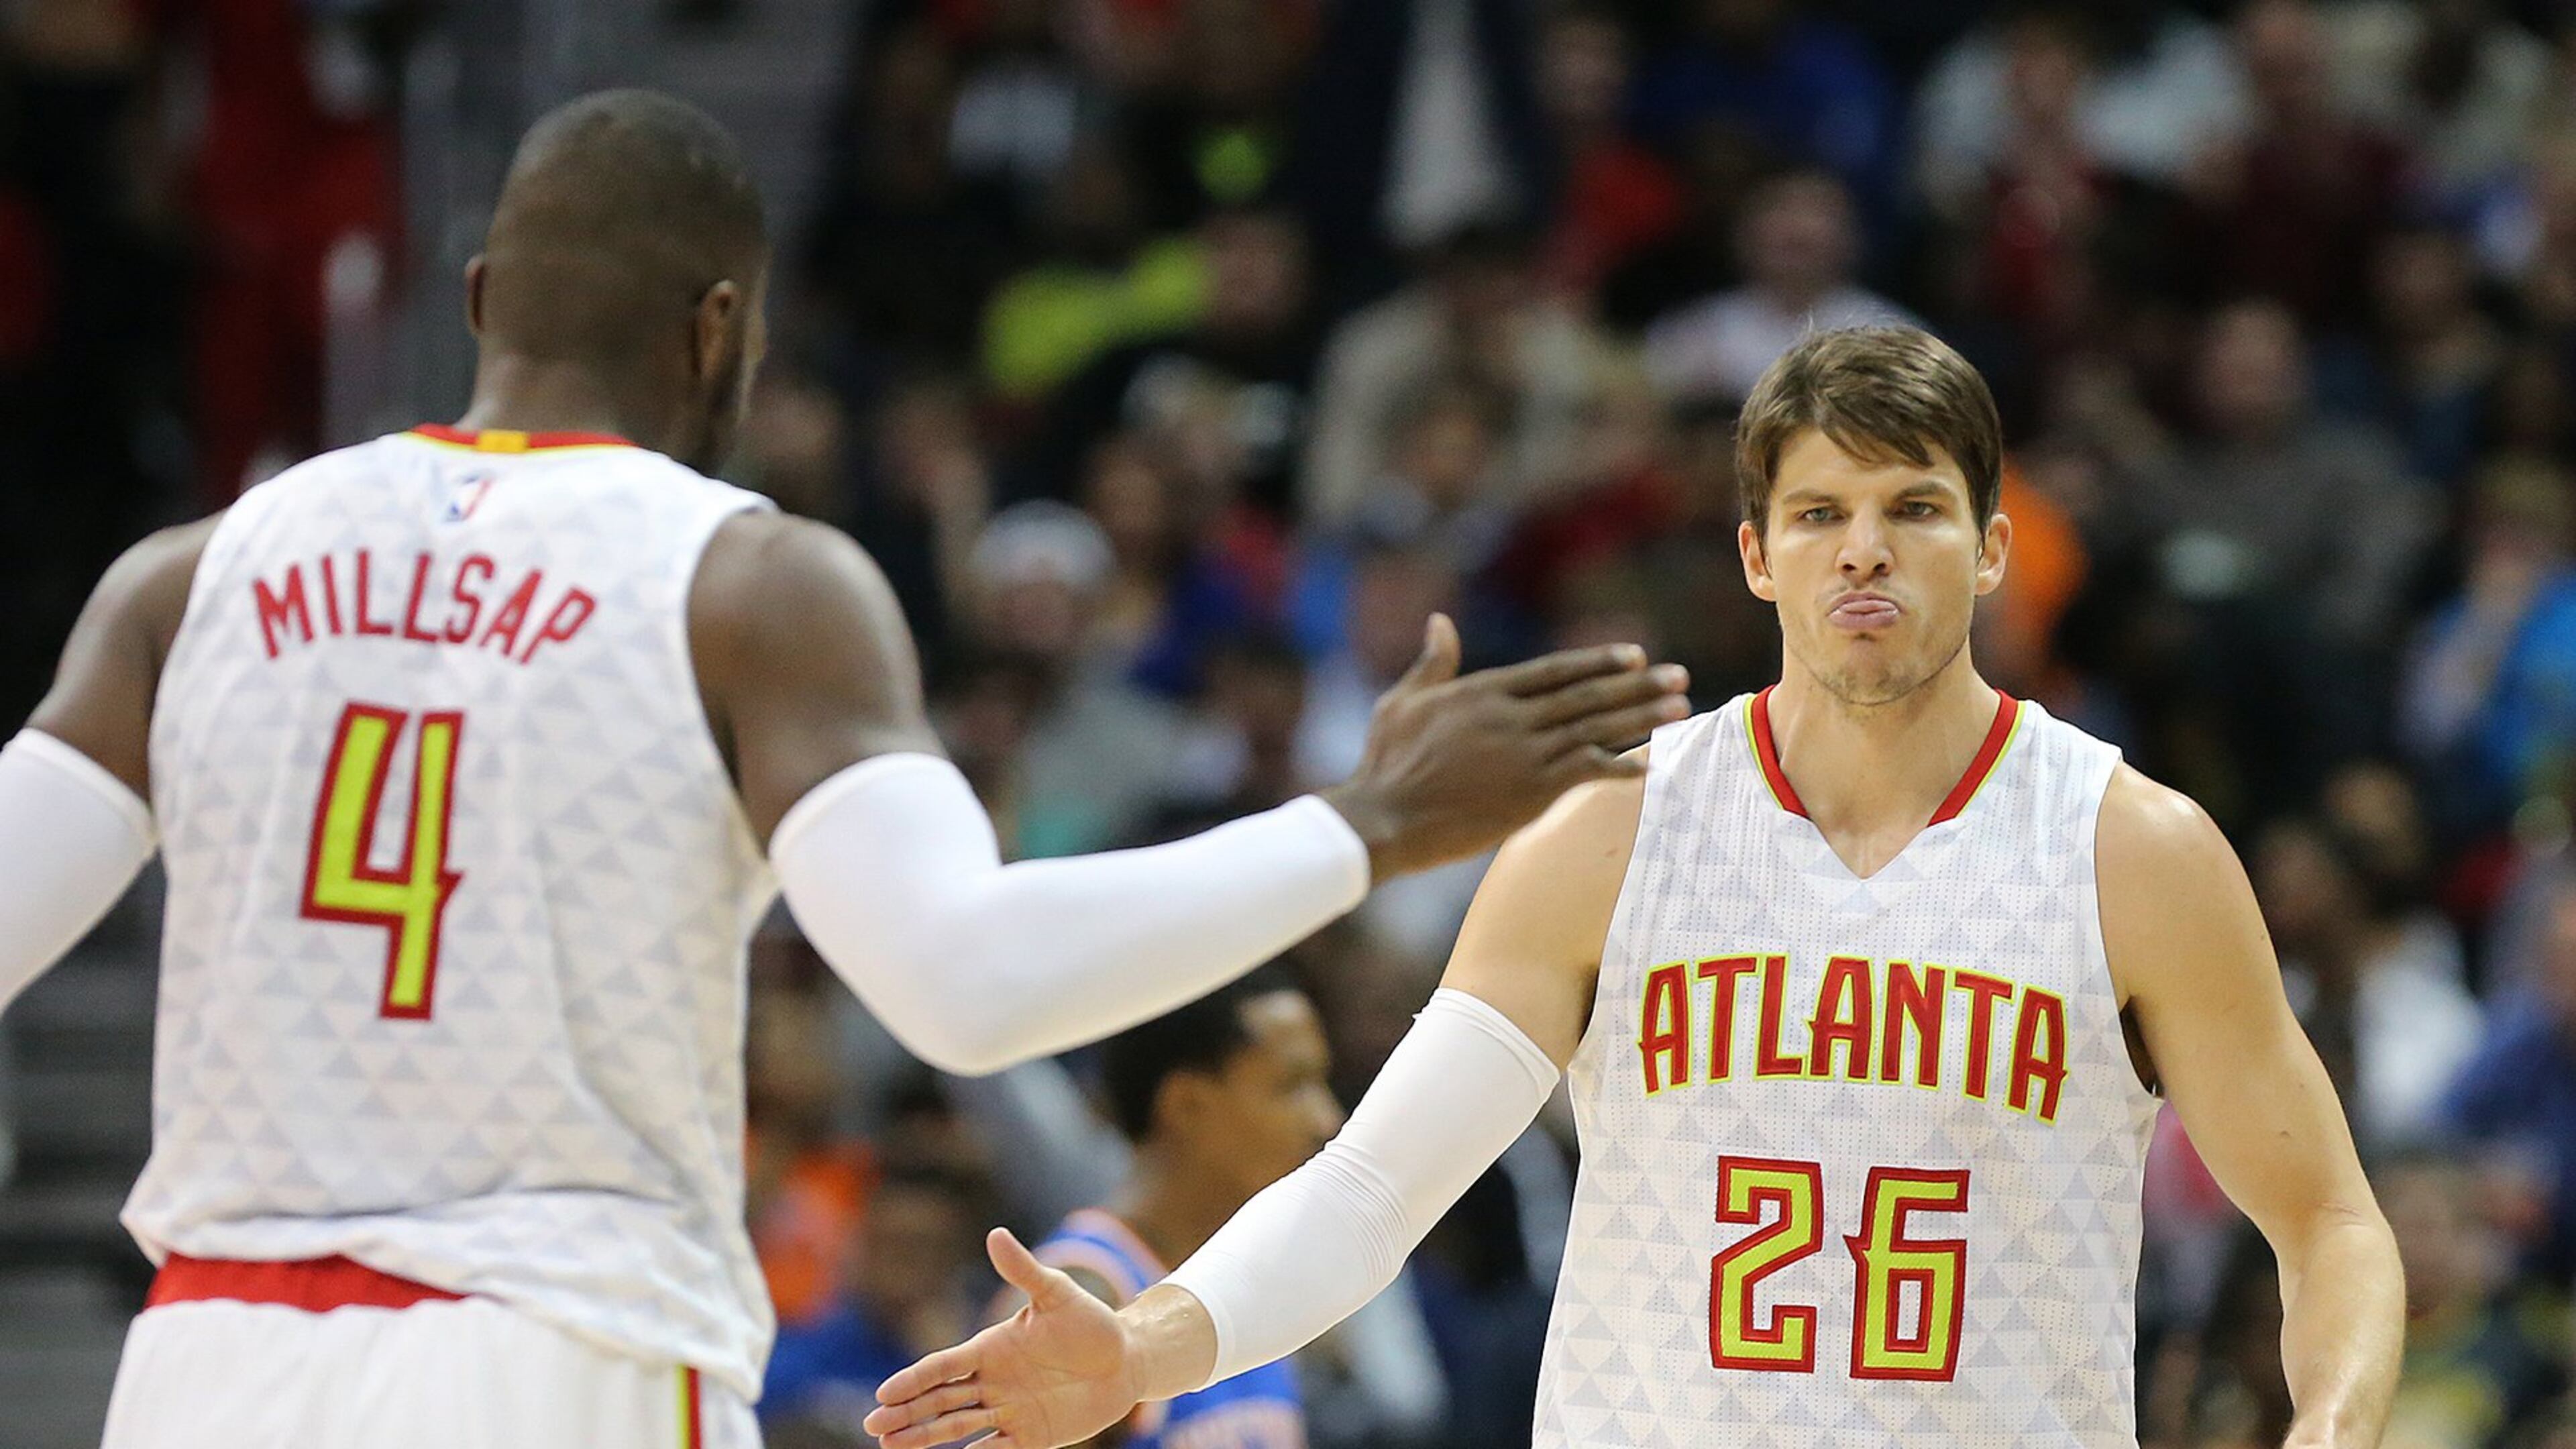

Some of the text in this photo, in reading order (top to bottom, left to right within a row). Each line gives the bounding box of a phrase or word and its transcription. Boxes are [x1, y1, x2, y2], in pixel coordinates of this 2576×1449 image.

[252, 547, 597, 665] MILLSAP
[300, 700, 464, 1021] 4
[1638, 952, 2070, 1125] ATLANTA
[1709, 1155, 1970, 1382] 26
